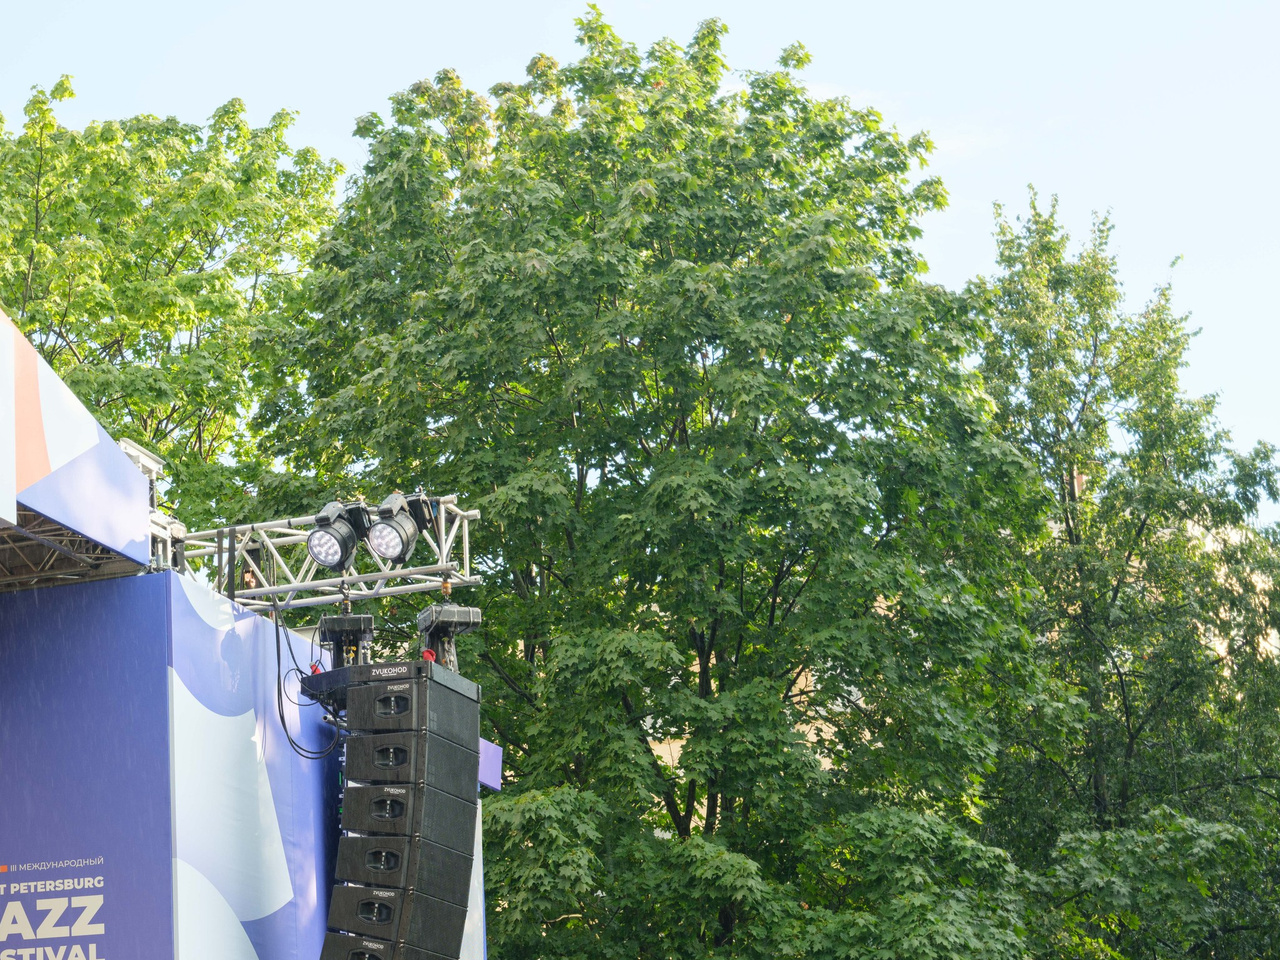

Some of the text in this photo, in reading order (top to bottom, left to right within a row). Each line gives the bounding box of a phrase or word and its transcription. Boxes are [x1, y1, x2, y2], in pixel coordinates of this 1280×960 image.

[371, 666, 408, 676] ZVUKOHOD
[19, 856, 104, 871] МЕЖДУНАРОДНЫЙ
[10, 876, 104, 895] PETERSBURG
